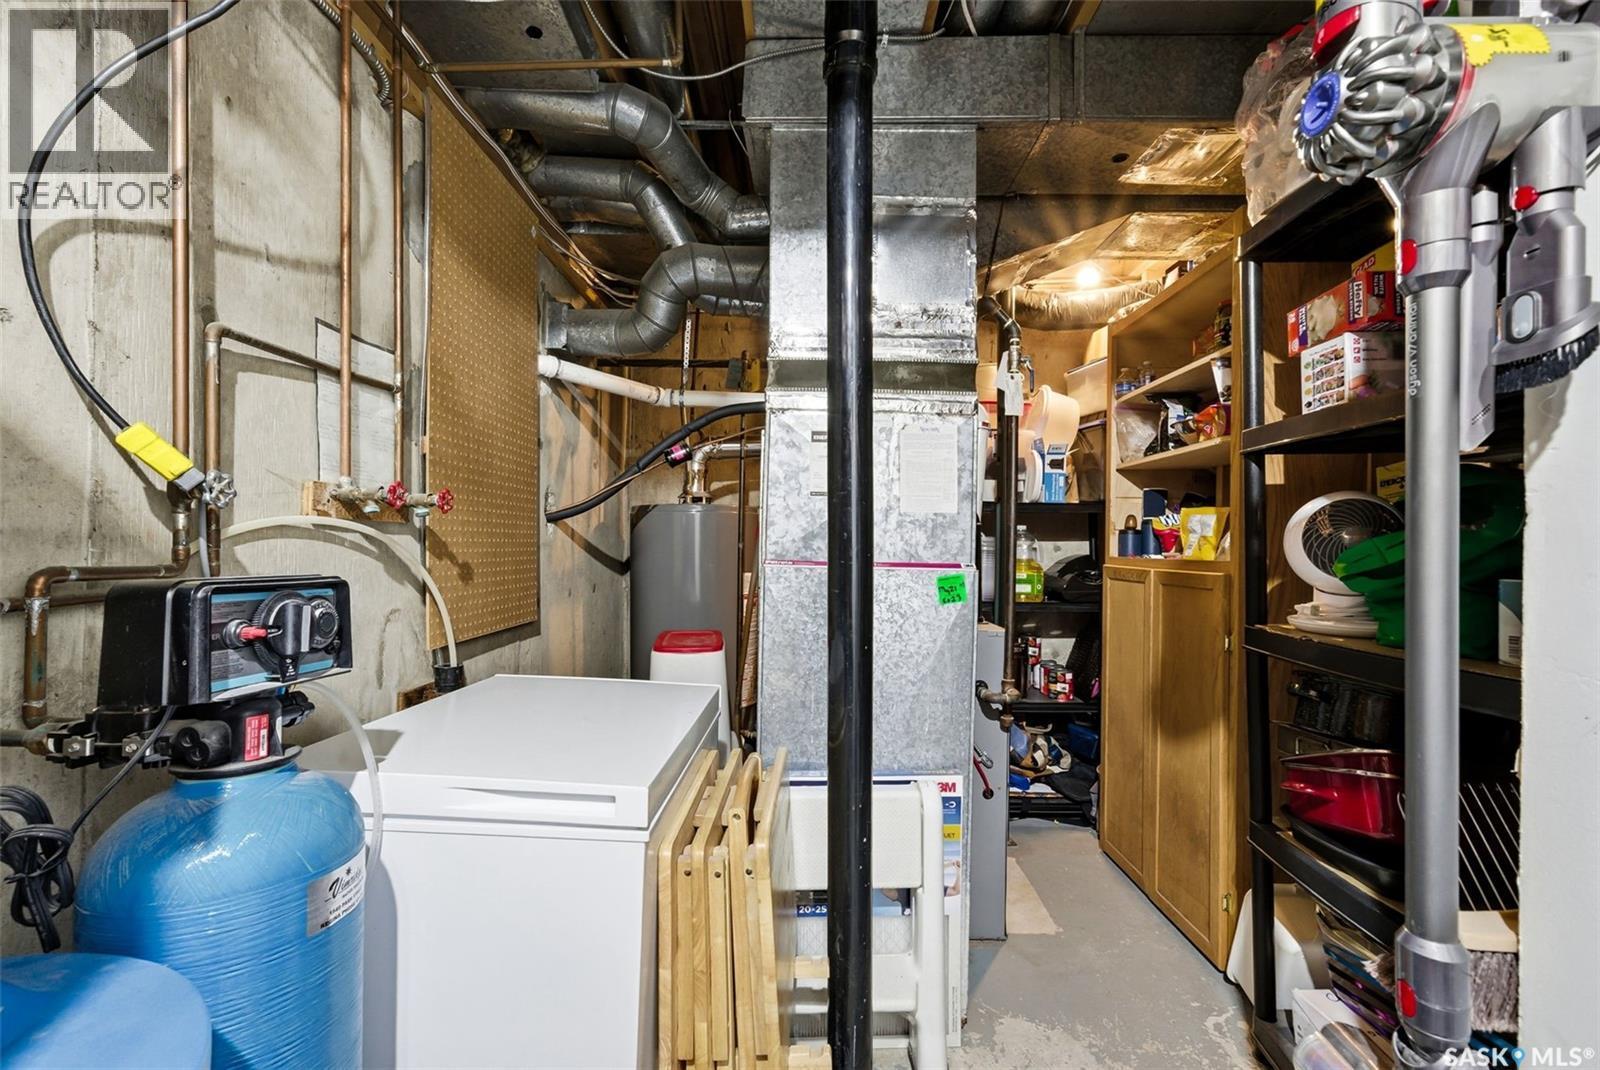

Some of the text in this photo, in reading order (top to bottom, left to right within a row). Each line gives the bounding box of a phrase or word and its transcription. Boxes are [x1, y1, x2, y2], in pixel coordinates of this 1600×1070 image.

[1354, 282, 1363, 317] Hefty
[1408, 302, 1417, 343] animal
[1408, 359, 1421, 396] dyson
[937, 782, 956, 793] 3M
